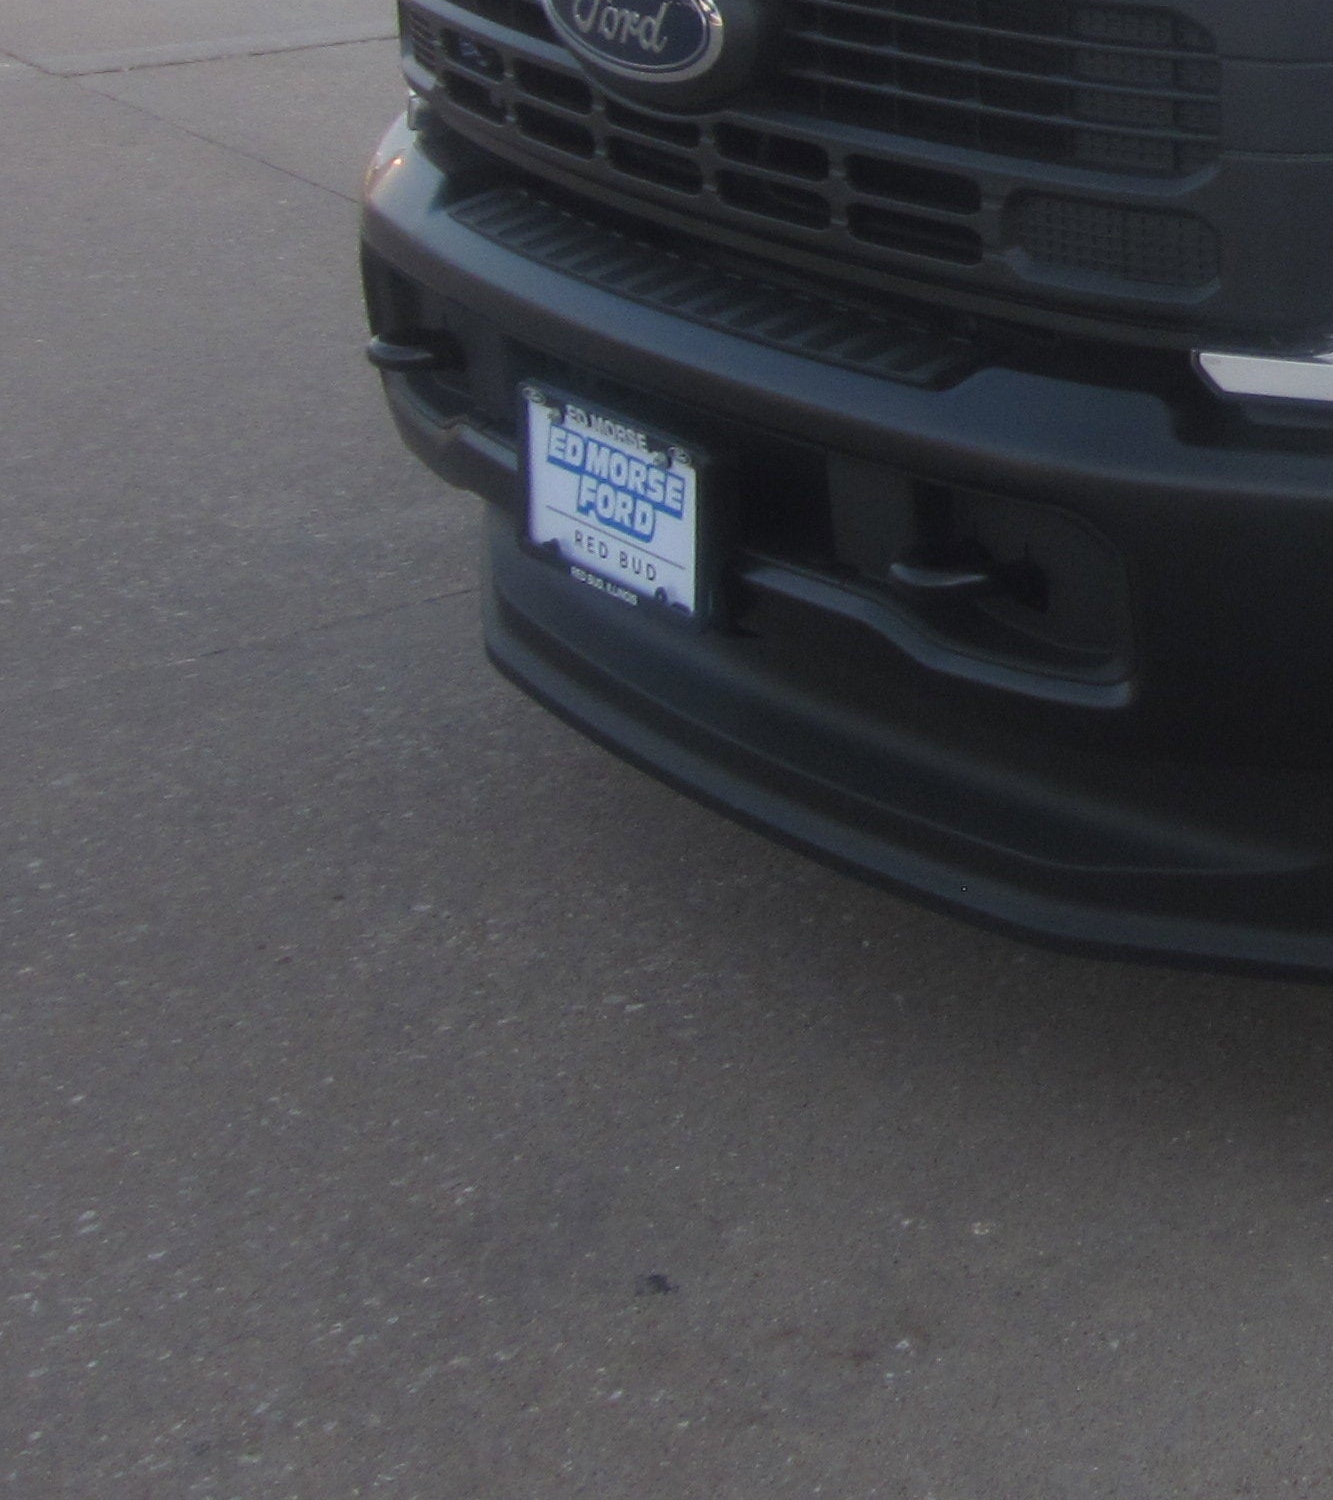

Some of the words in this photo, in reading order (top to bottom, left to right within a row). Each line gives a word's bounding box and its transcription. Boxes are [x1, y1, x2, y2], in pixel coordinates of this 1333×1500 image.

[590, 414, 648, 452] MORSE
[548, 424, 584, 473] ED
[584, 436, 685, 520] MORSE
[577, 474, 656, 543] FORD
[574, 529, 608, 559] RED
[619, 550, 656, 581] BUD
